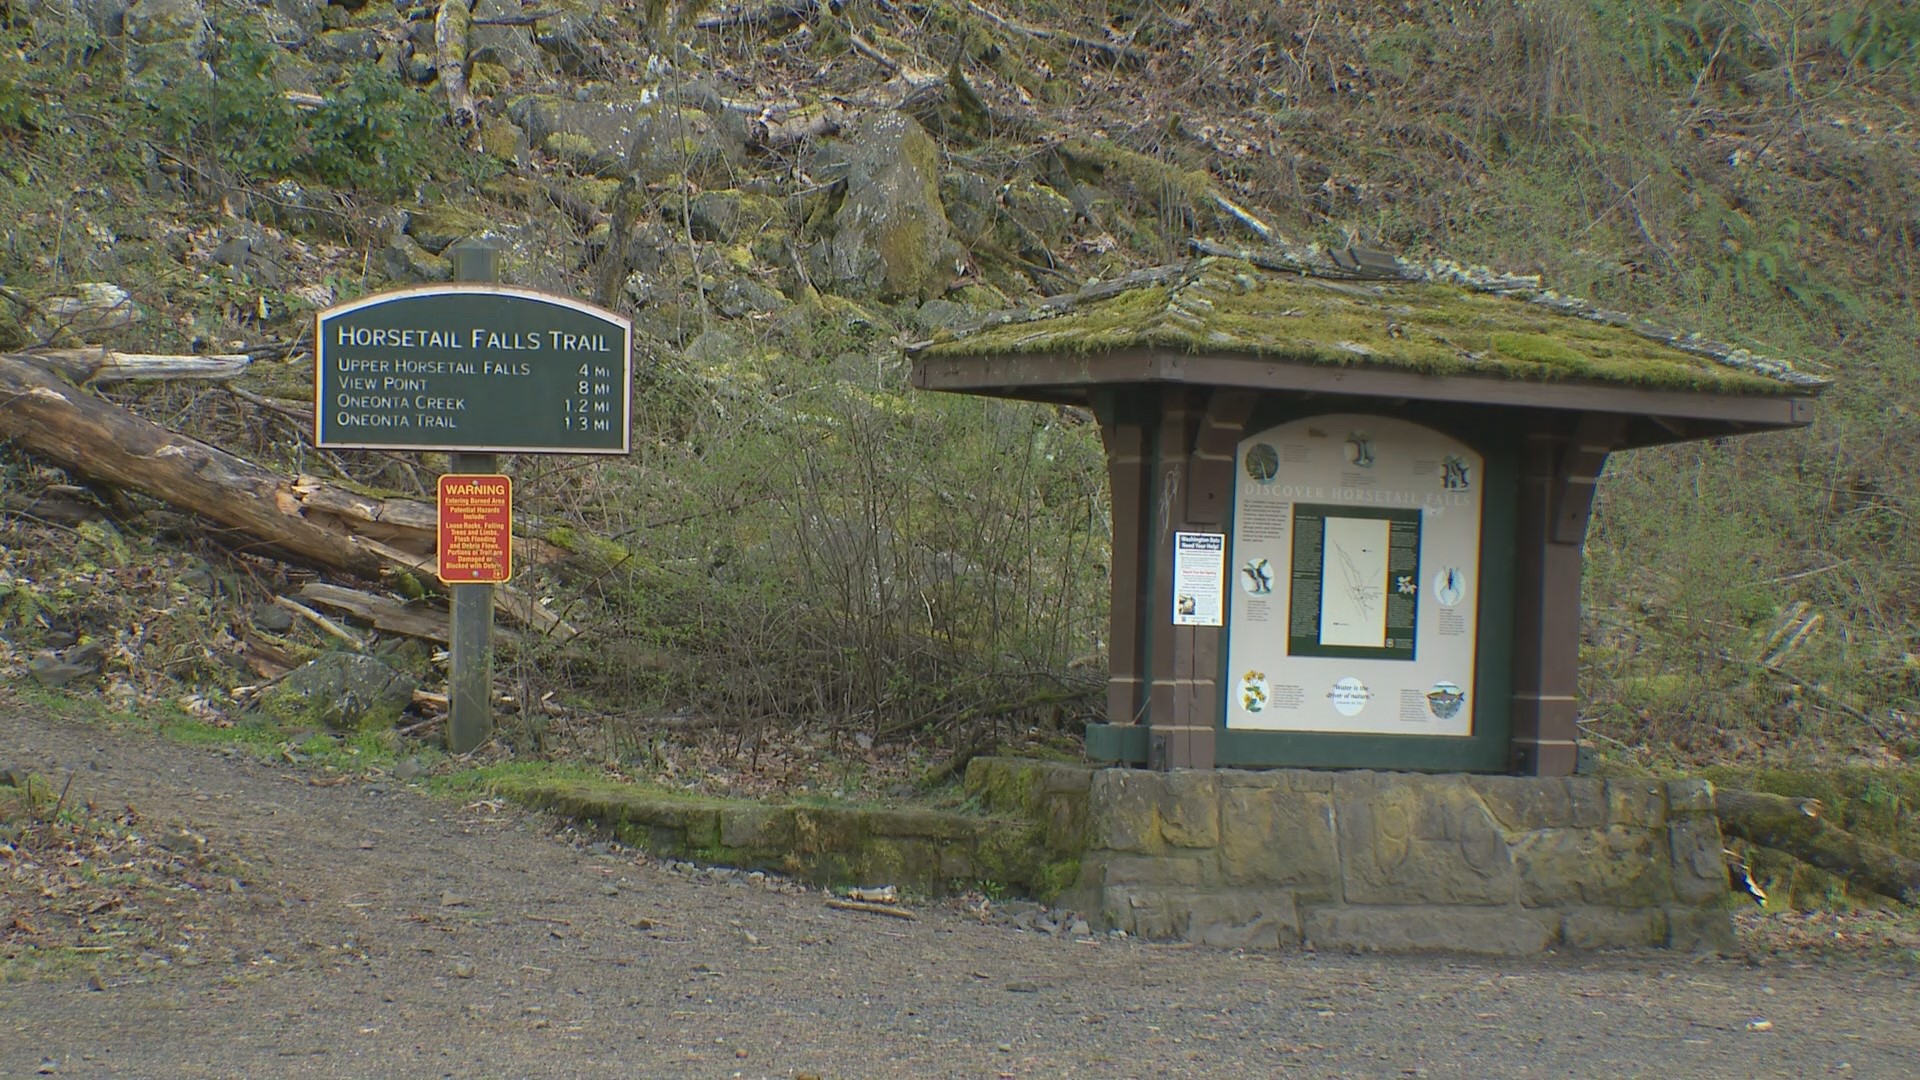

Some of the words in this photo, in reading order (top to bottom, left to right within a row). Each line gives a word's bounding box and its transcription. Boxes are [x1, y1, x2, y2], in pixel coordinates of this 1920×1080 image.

[337, 325, 463, 348] HORSETAIL
[471, 329, 541, 350] FALLS
[548, 330, 611, 351] TRAIL
[337, 358, 389, 372] UPPER
[394, 359, 477, 374] HORSETAIL
[483, 360, 530, 375] FALLS
[338, 375, 377, 390] VIEW
[384, 376, 427, 391] POINT
[337, 393, 410, 408] ONEONTA
[415, 395, 466, 410] CREEK
[337, 411, 410, 426] ONEONTA
[416, 413, 457, 428] TRAIL
[445, 485, 505, 495] WARNING
[1244, 484, 1324, 498] DISCOVER
[1332, 487, 1418, 504] HORSETAIL
[1426, 492, 1471, 505] FALLS
[484, 522, 504, 530] Falling
